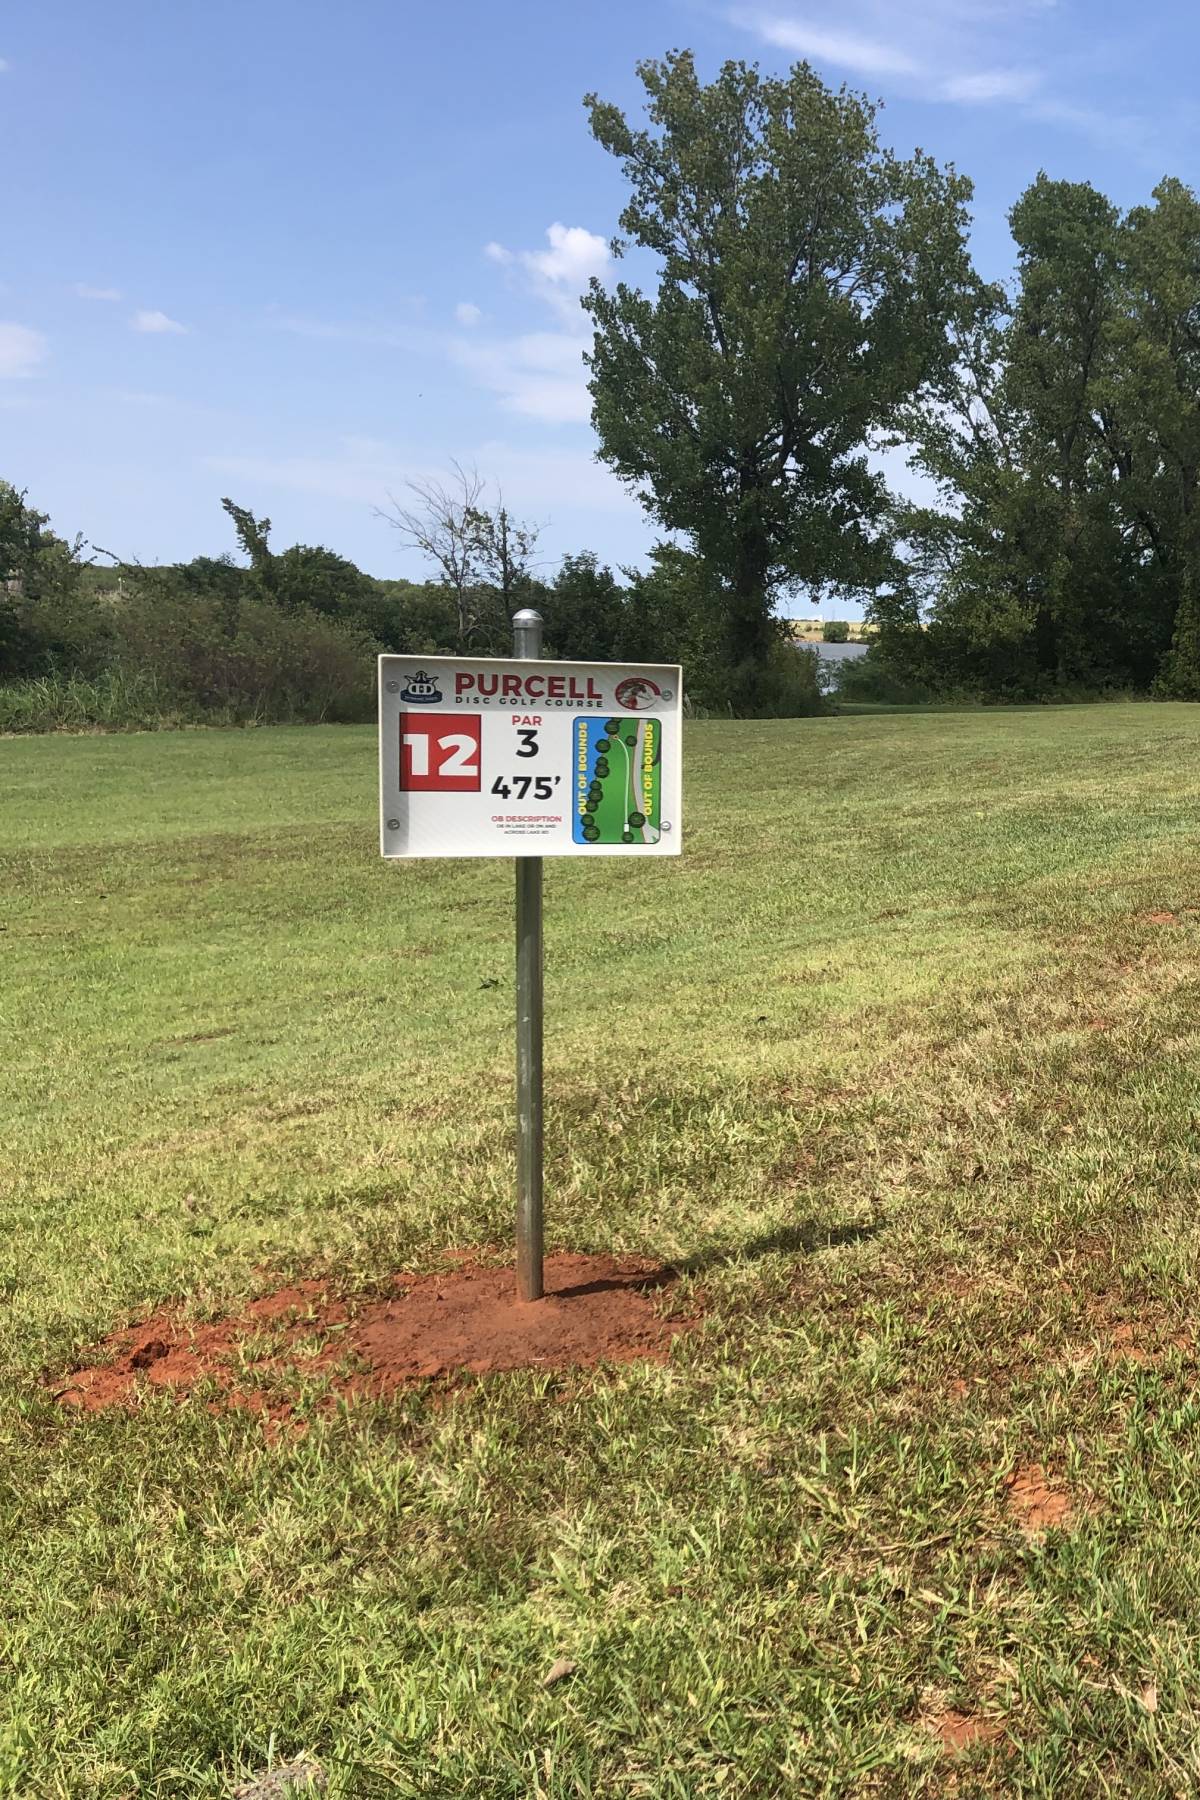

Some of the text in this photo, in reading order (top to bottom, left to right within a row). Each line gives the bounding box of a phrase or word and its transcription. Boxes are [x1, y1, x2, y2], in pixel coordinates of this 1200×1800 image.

[455, 672, 603, 699] PURCELL
[455, 696, 603, 708] DISC GOLF COURSE
[511, 715, 543, 726] PAR
[403, 733, 478, 776] 12
[515, 729, 539, 758] 3
[578, 722, 588, 816] OUT OF BOUNDS
[644, 723, 654, 816] OUT OF BOUNDS
